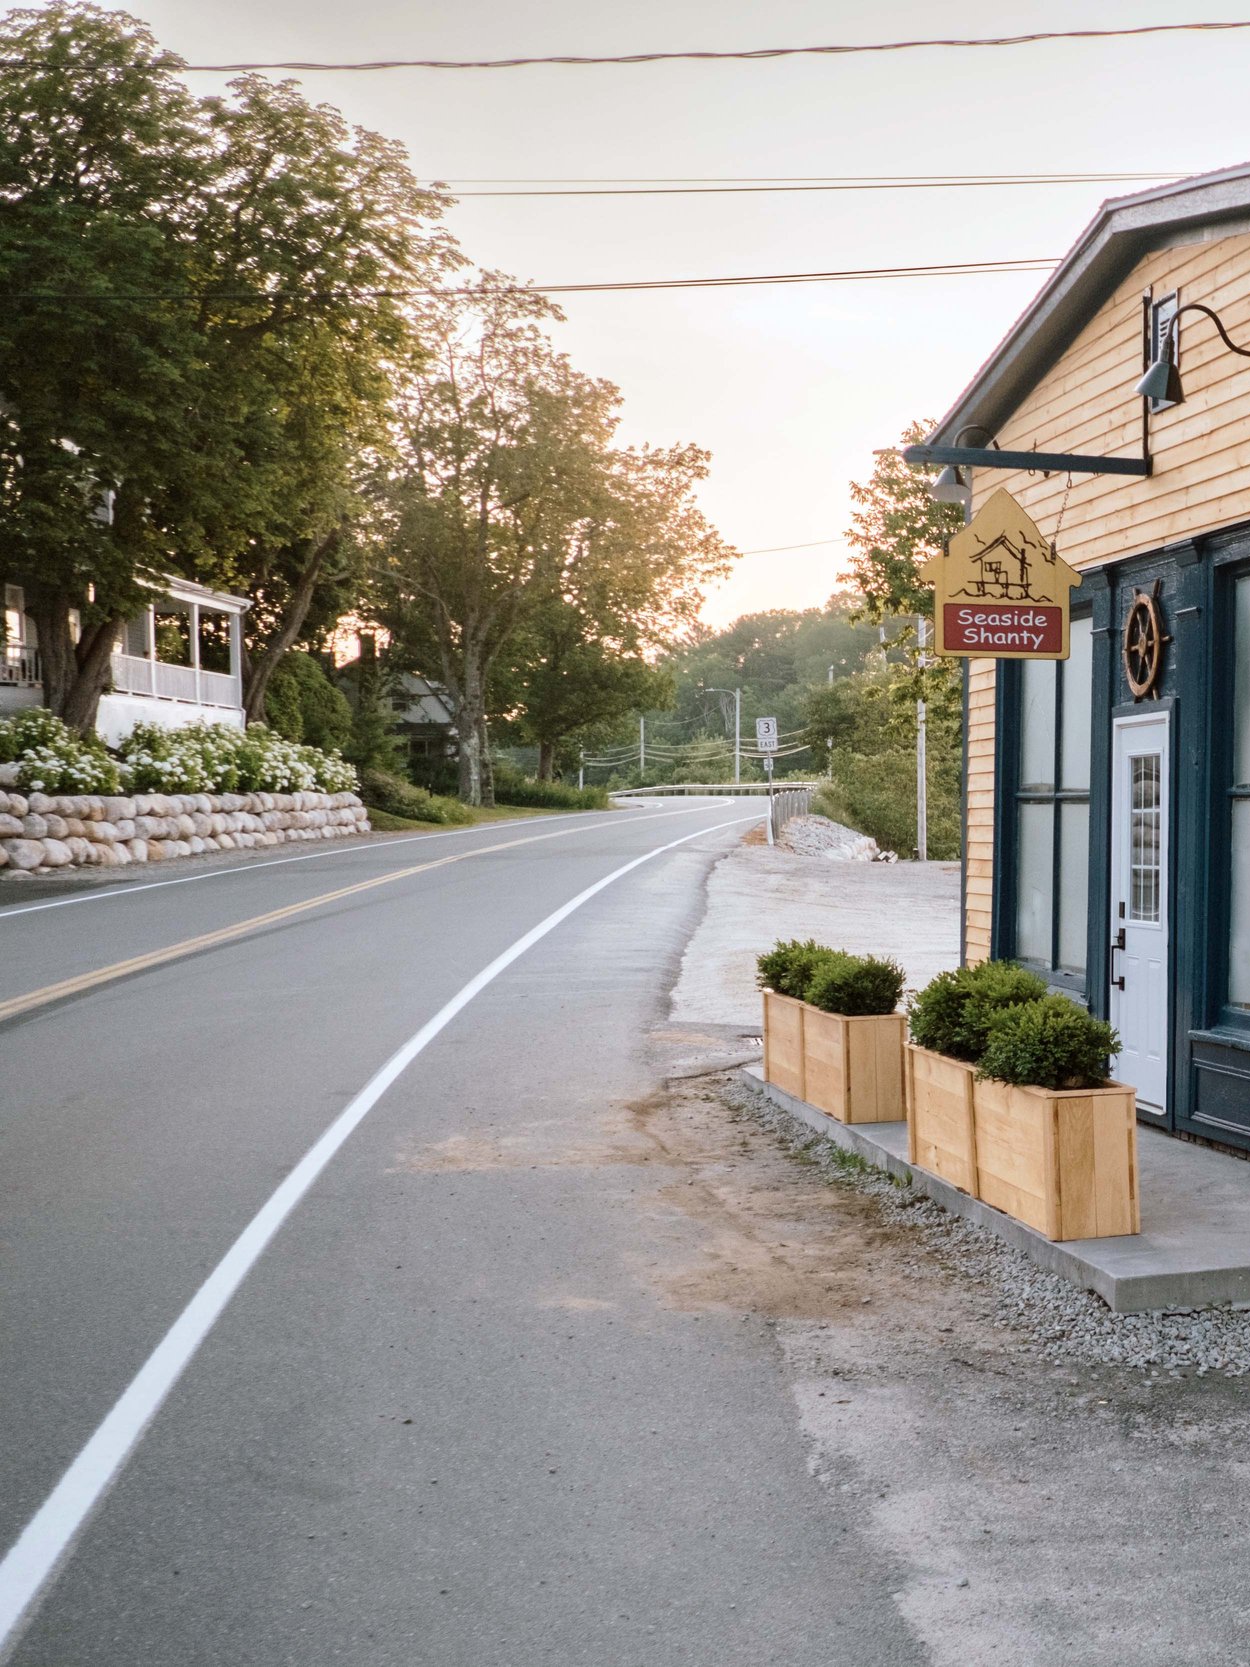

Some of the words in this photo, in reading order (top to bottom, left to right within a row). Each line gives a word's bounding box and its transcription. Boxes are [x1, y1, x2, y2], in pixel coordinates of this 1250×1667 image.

[957, 609, 1048, 627] Seaside
[962, 627, 1044, 650] Shanty
[763, 722, 771, 734] 3
[760, 741, 775, 749] EAST
